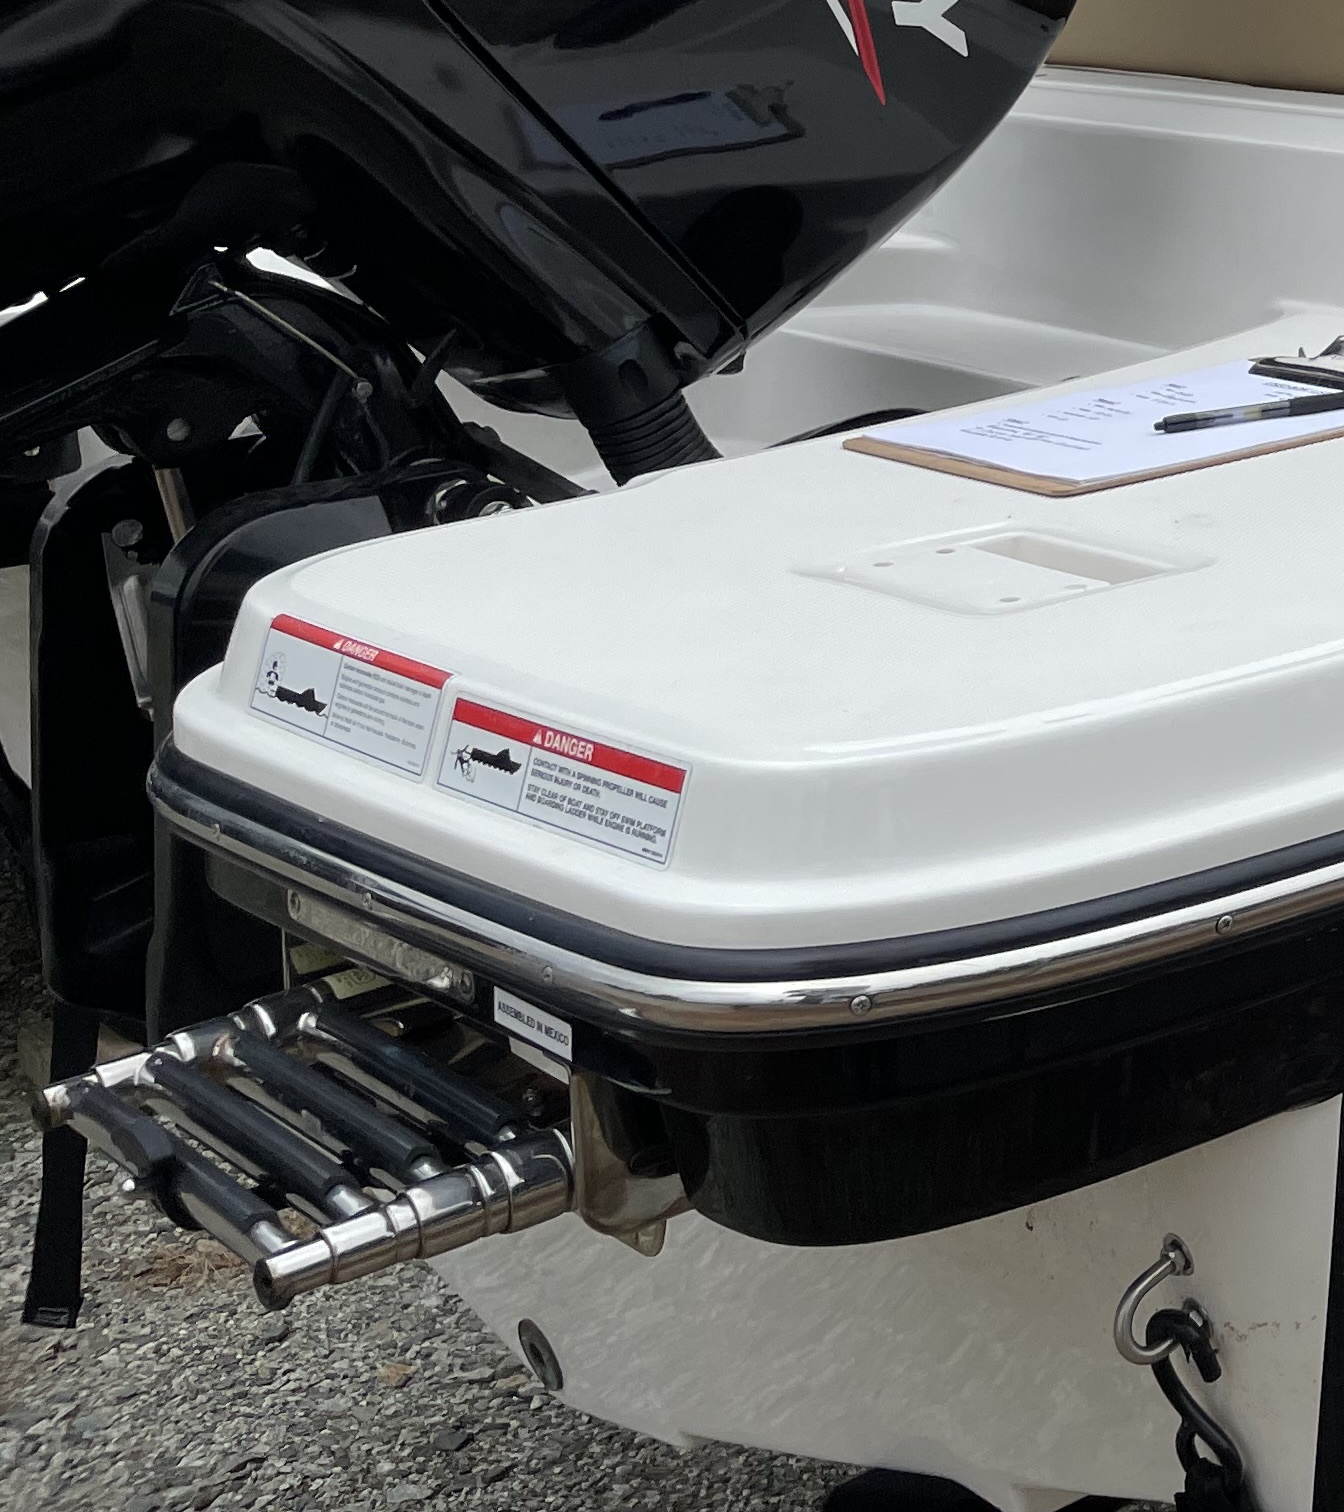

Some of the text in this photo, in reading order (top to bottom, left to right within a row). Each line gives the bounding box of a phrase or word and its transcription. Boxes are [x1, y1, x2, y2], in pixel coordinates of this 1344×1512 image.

[341, 640, 379, 662] DANGER
[544, 731, 594, 761] DANGER
[497, 1001, 569, 1046] ASSEMBLED IN MEXICO
